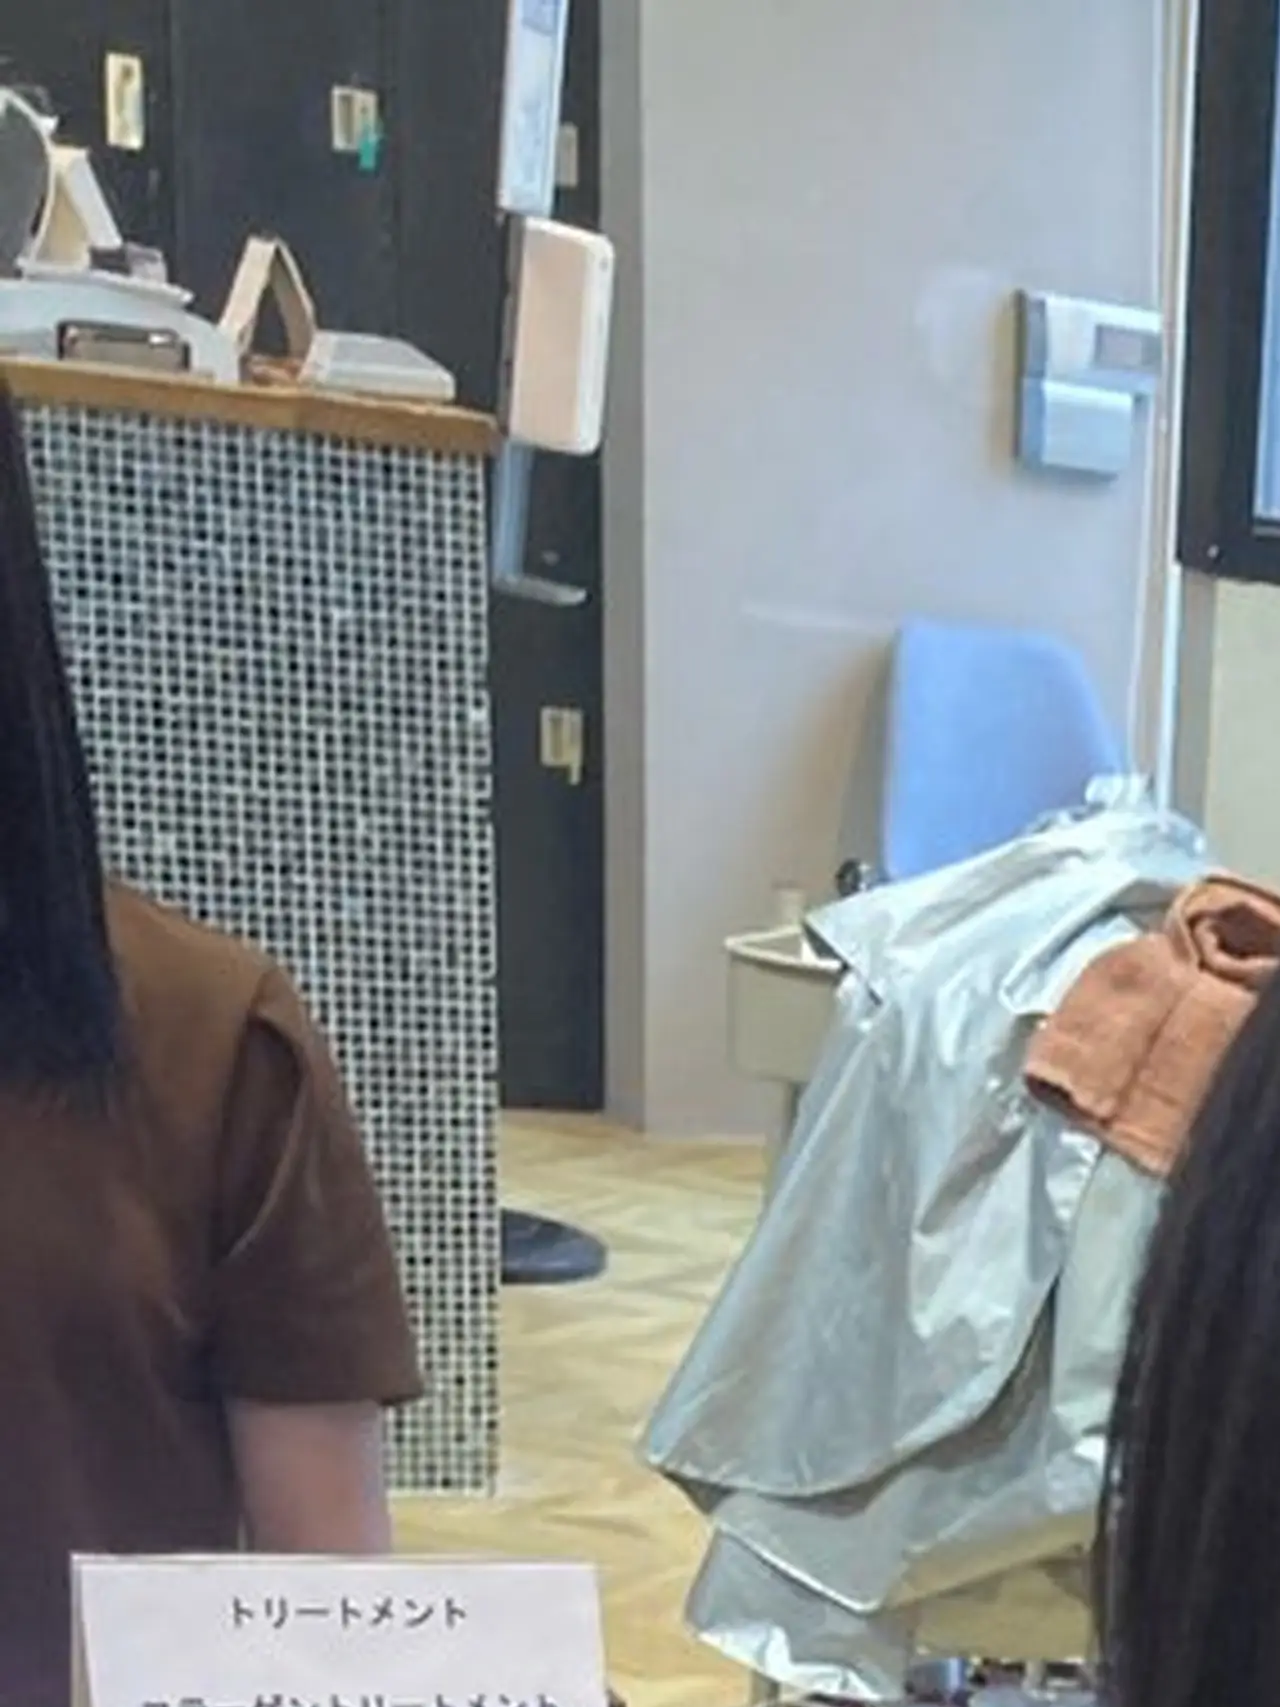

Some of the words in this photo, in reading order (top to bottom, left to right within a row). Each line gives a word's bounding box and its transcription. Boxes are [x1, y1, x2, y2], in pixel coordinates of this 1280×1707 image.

[232, 1596, 466, 1630] トリートメント
